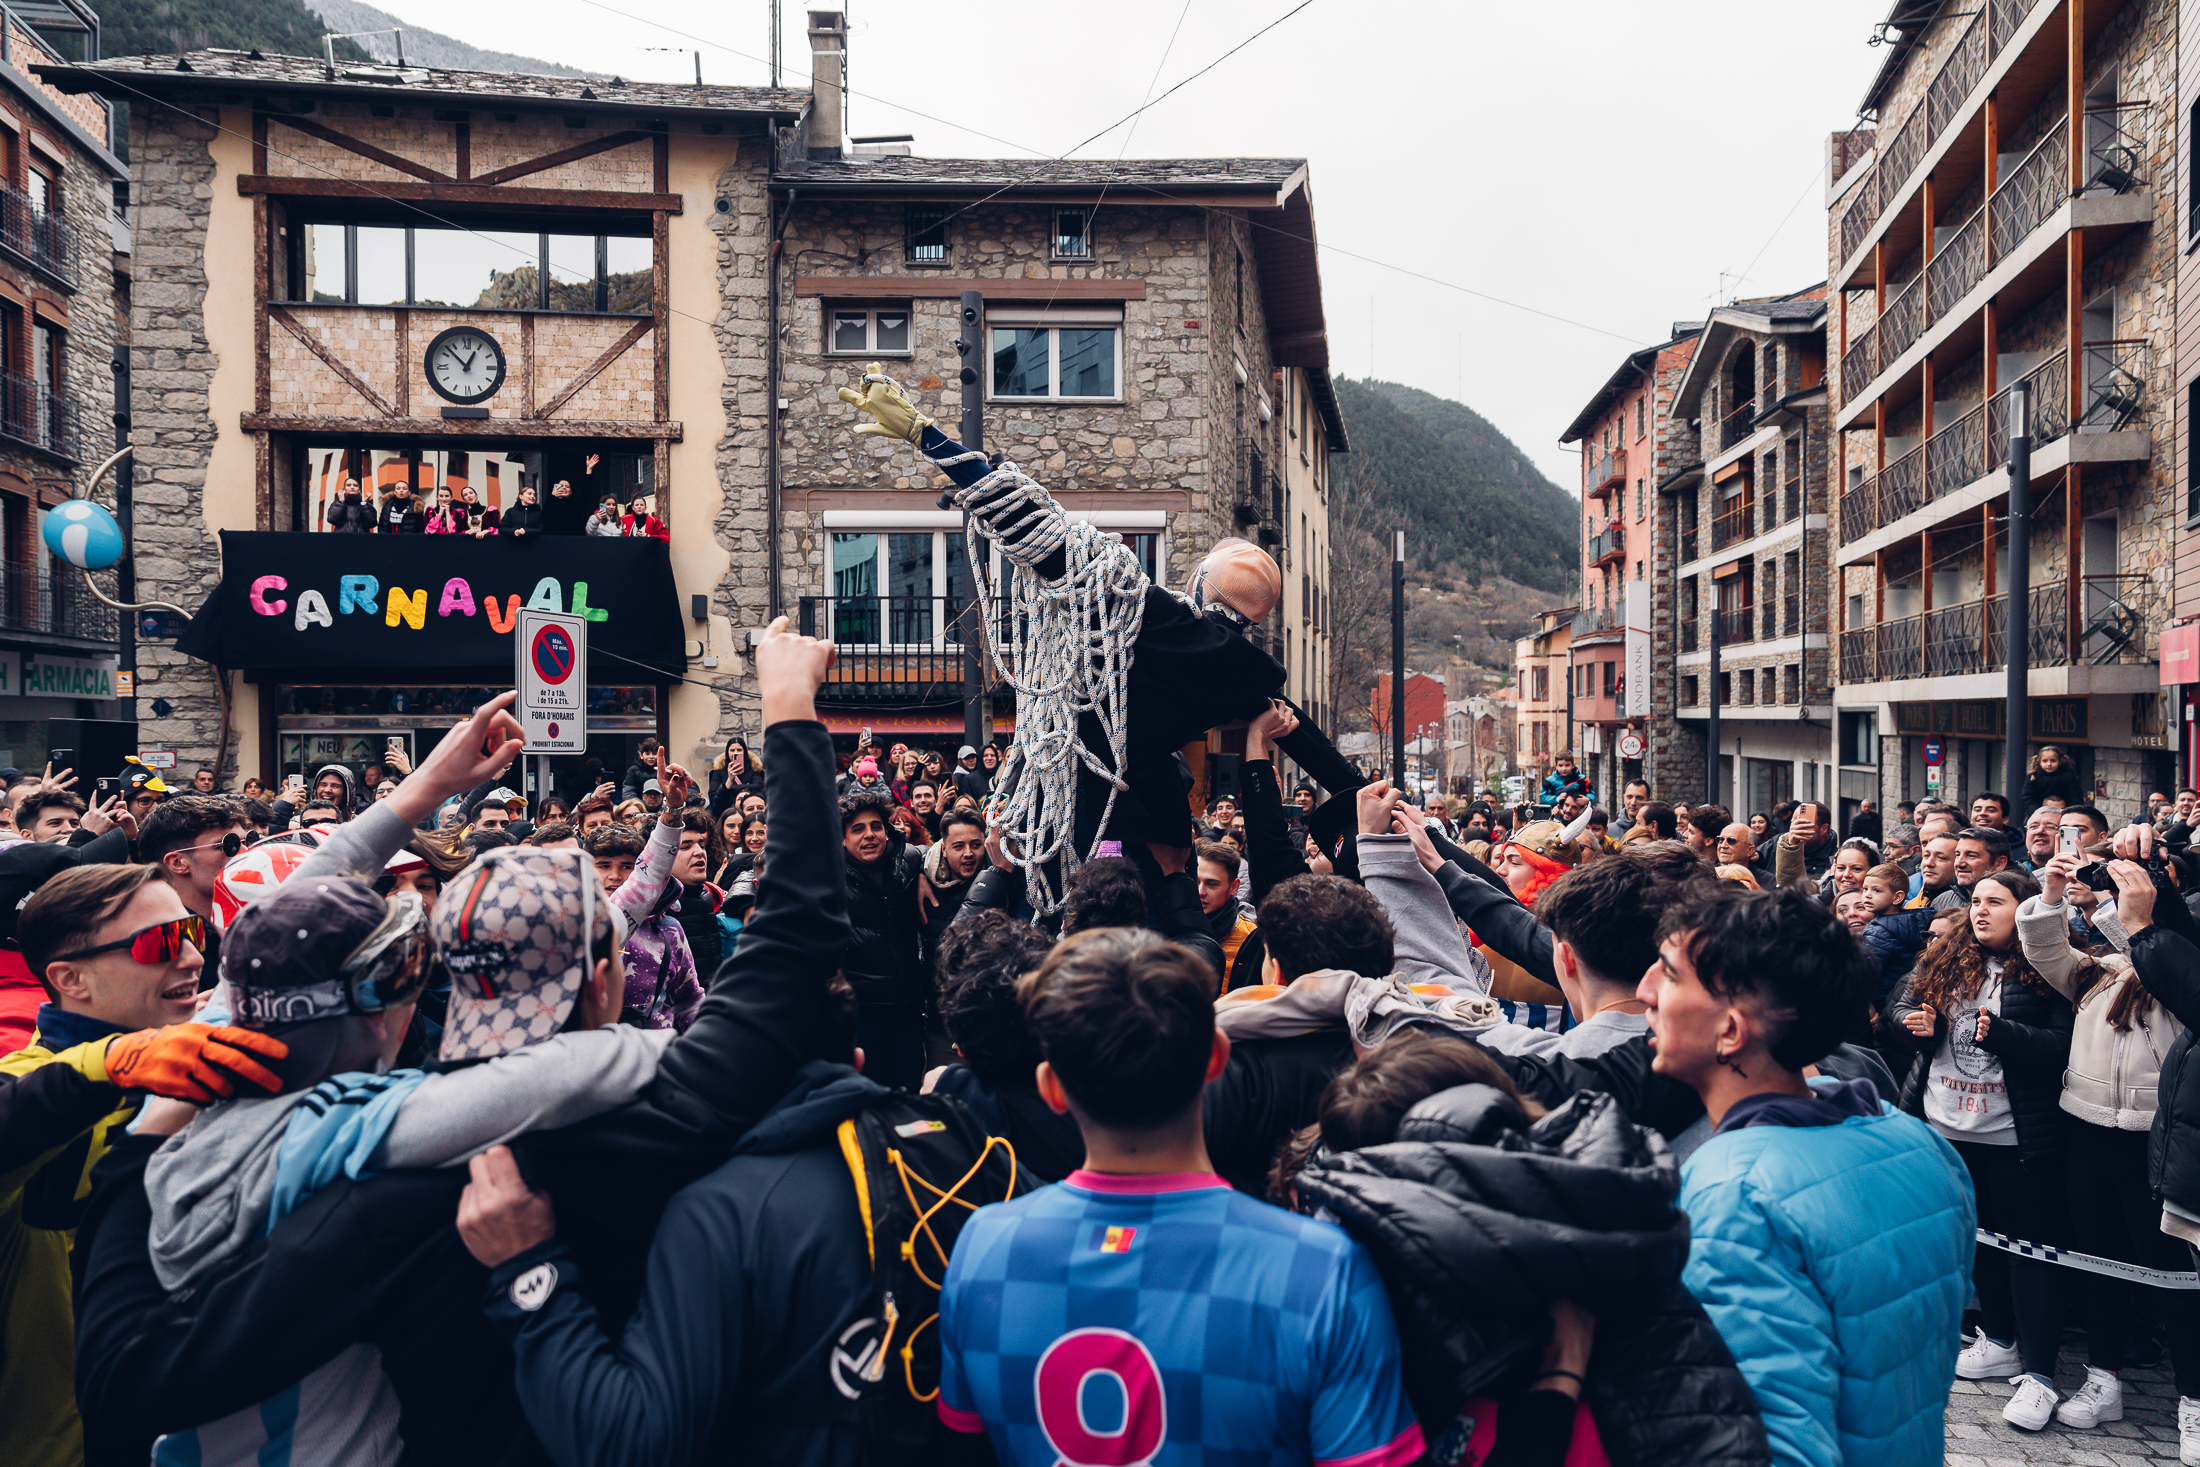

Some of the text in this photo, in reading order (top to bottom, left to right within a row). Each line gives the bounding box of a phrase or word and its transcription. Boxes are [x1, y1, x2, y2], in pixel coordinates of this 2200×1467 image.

[249, 574, 609, 634] CARNAVAL
[1635, 644, 1644, 713] ANDBANK
[556, 689, 566, 697] 13h.
[531, 711, 575, 721] FORA D'HORARIS
[1905, 703, 2077, 733] PARIS HOTEL PARIS
[875, 717, 950, 726] CIGAR
[532, 740, 550, 748] PROHIBIT
[2131, 736, 2164, 746] HOTEL
[317, 740, 340, 754] NEU
